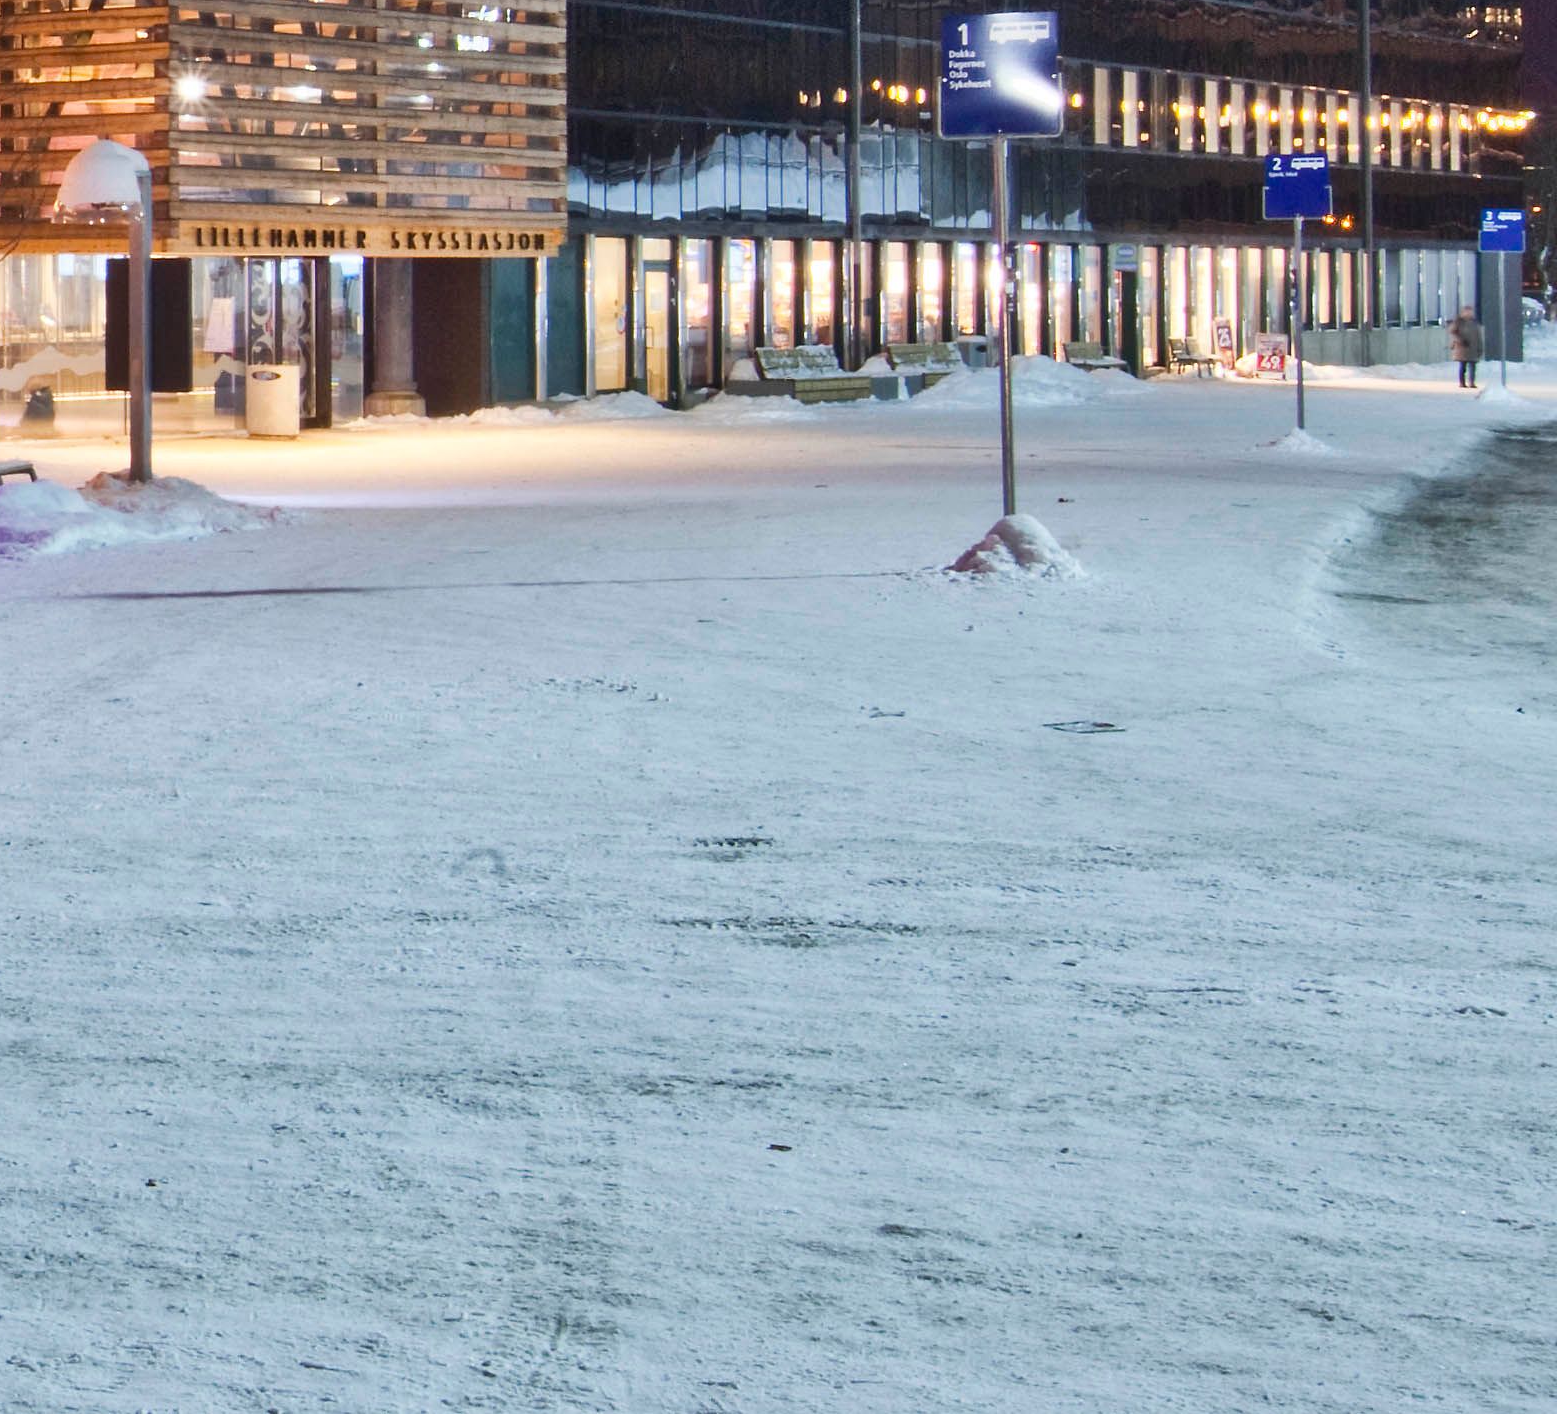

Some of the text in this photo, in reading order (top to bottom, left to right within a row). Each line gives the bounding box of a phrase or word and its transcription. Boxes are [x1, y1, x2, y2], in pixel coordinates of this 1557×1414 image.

[957, 23, 968, 46] 1
[948, 50, 976, 58] Dokka
[948, 61, 986, 70] Fagernes
[1272, 157, 1282, 171] 2
[1485, 210, 1493, 221] 3
